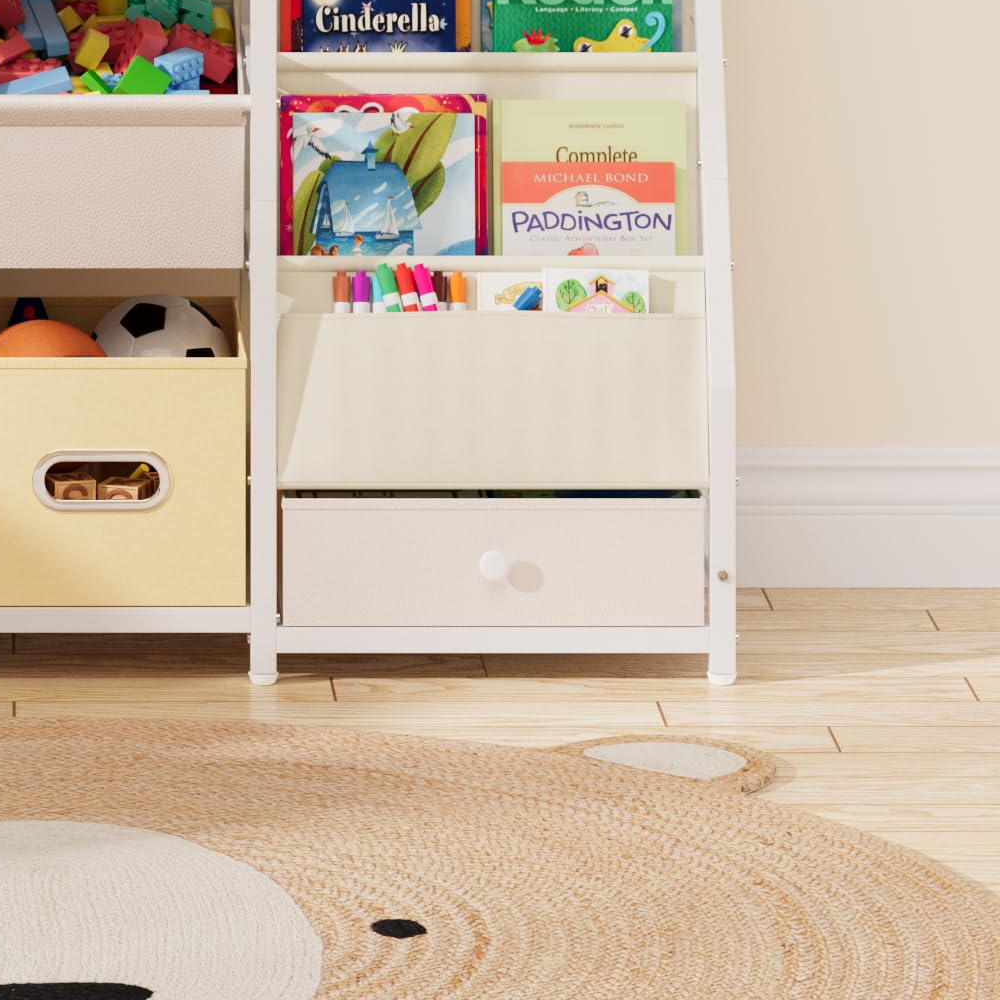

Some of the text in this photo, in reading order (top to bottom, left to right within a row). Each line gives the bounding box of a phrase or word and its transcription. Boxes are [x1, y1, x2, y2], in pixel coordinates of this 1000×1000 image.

[315, 3, 441, 33] Cinderella
[534, 172, 649, 183] MICHAEL BOND
